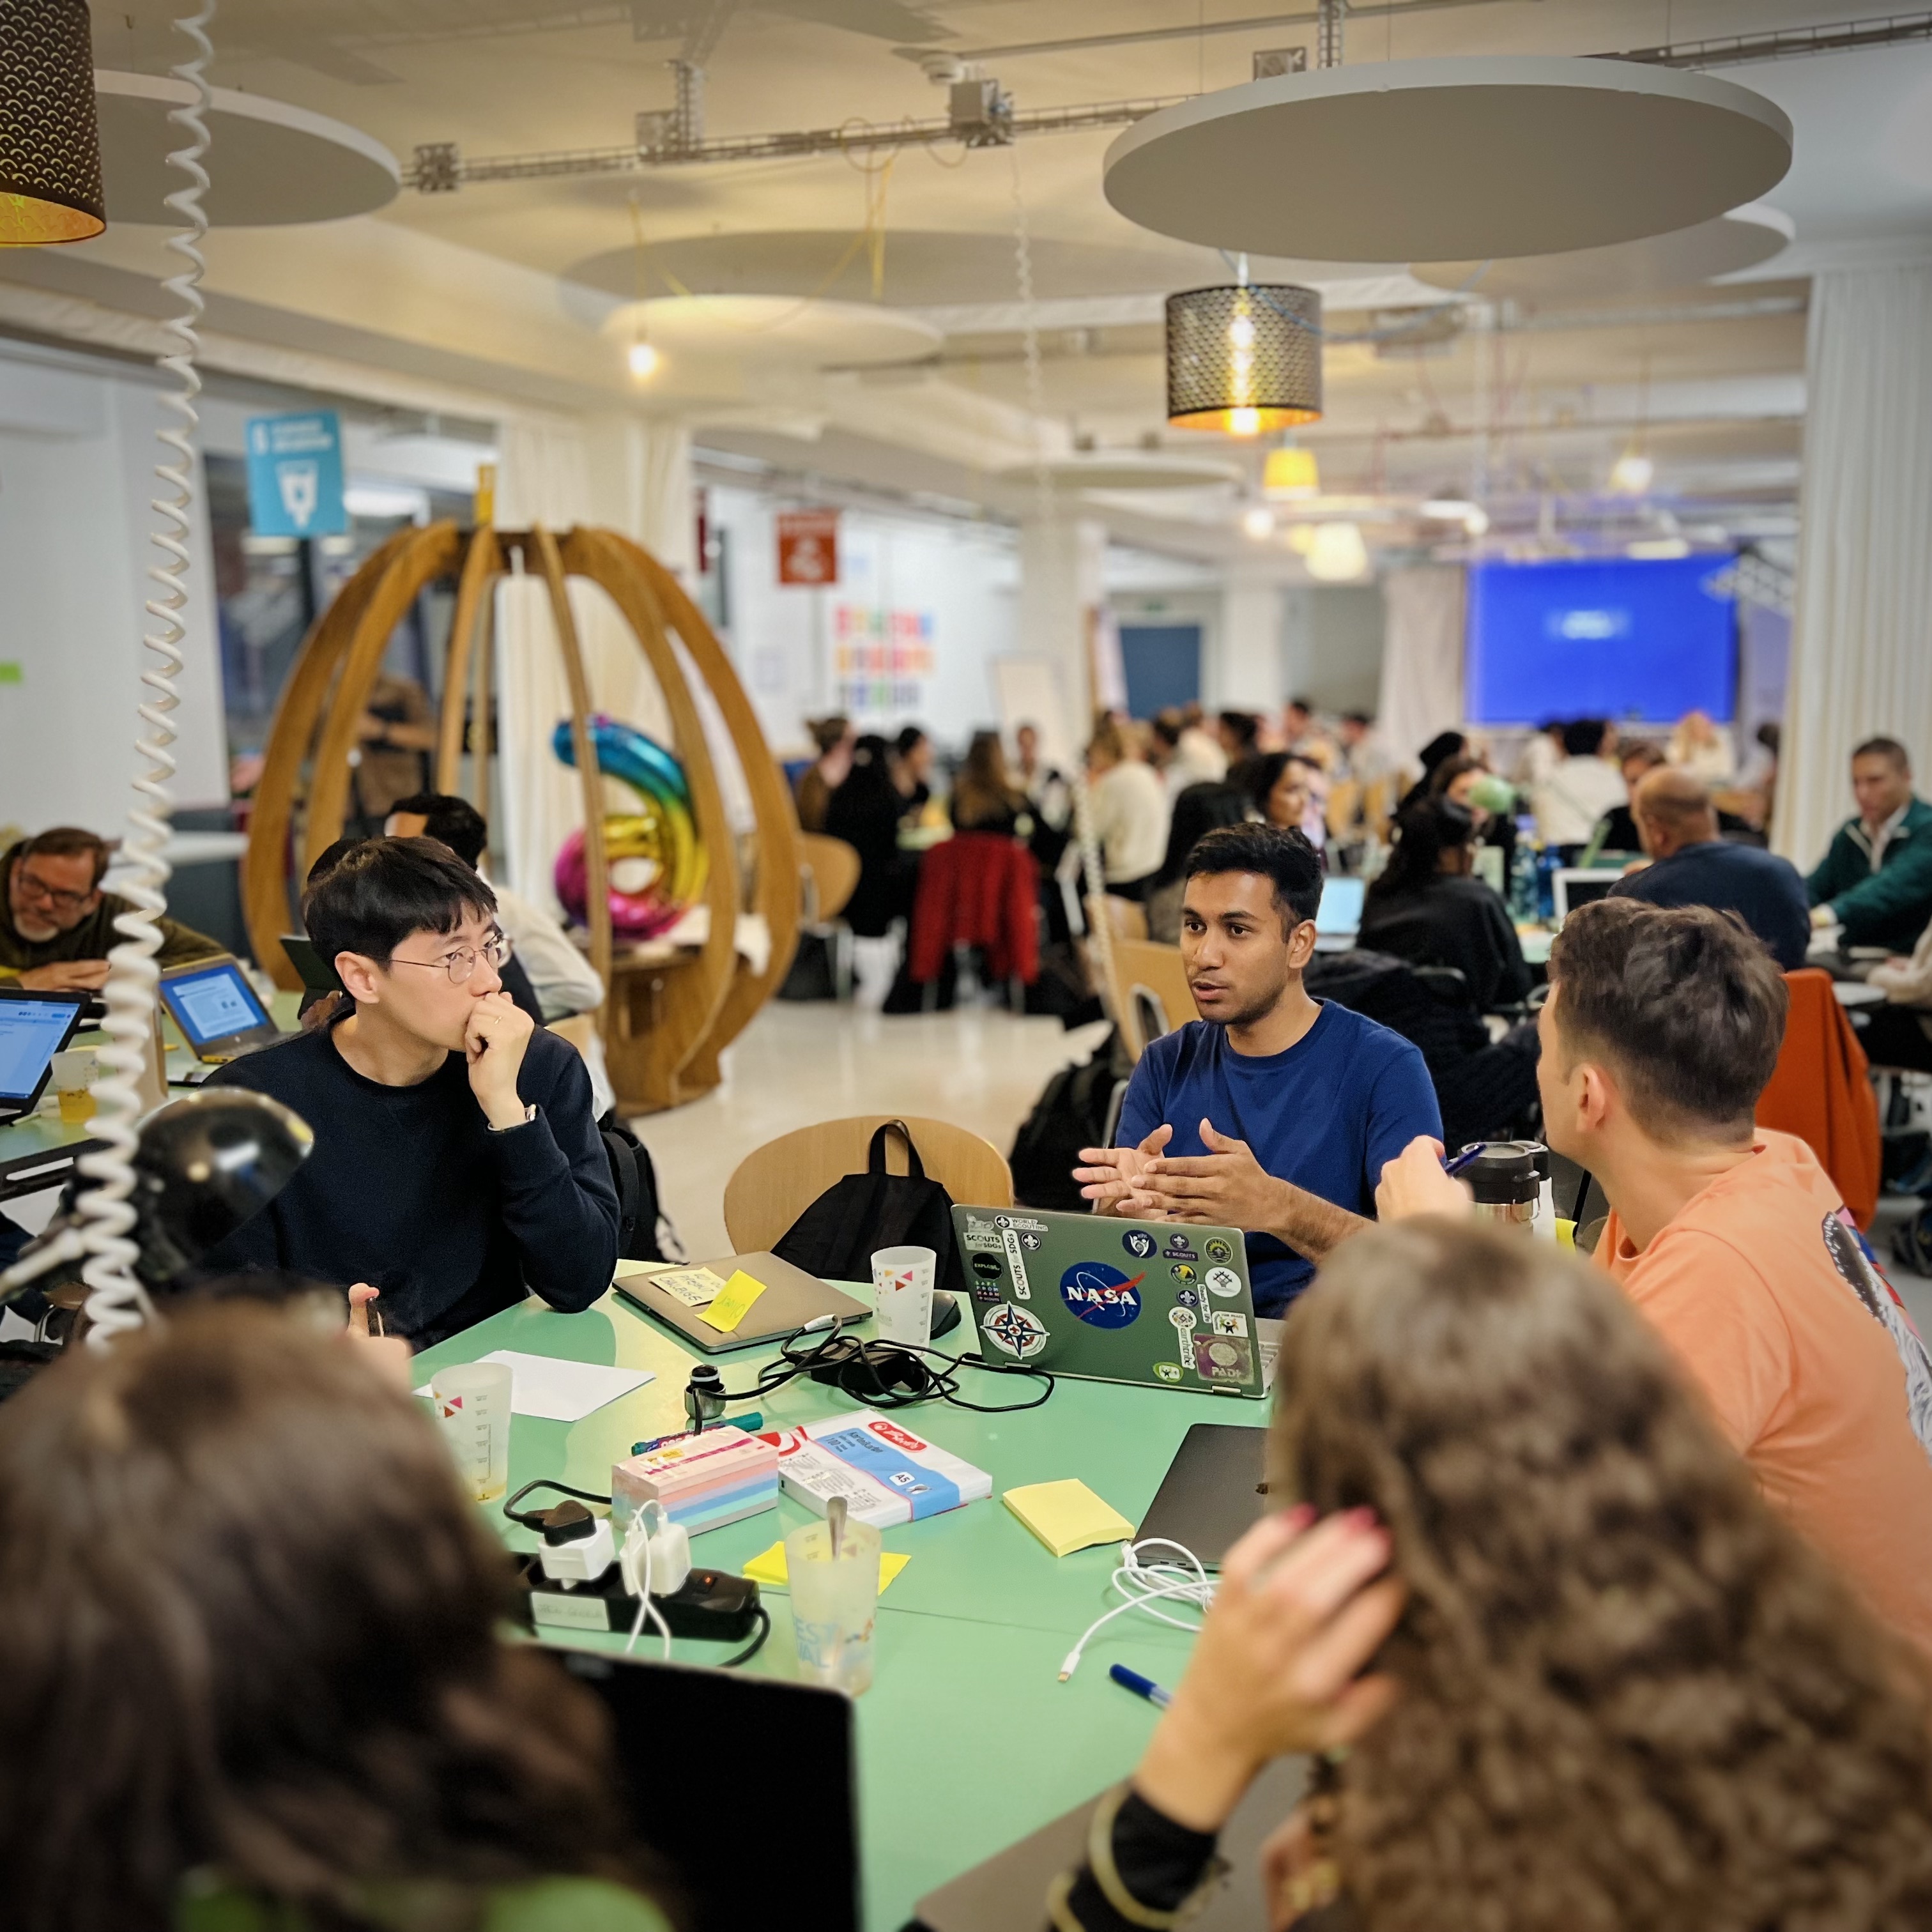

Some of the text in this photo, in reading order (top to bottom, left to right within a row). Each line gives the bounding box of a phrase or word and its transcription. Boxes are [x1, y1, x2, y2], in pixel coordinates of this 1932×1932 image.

[966, 1234, 1000, 1243] SCOUTS
[1008, 1233, 1018, 1254] SDGs
[1172, 1251, 1196, 1259] SCOUTS
[1013, 1265, 1027, 1296] SCOUTS
[1066, 1286, 1137, 1305] NASA
[1199, 1285, 1208, 1303] Ready
[894, 1473, 911, 1483] A5
